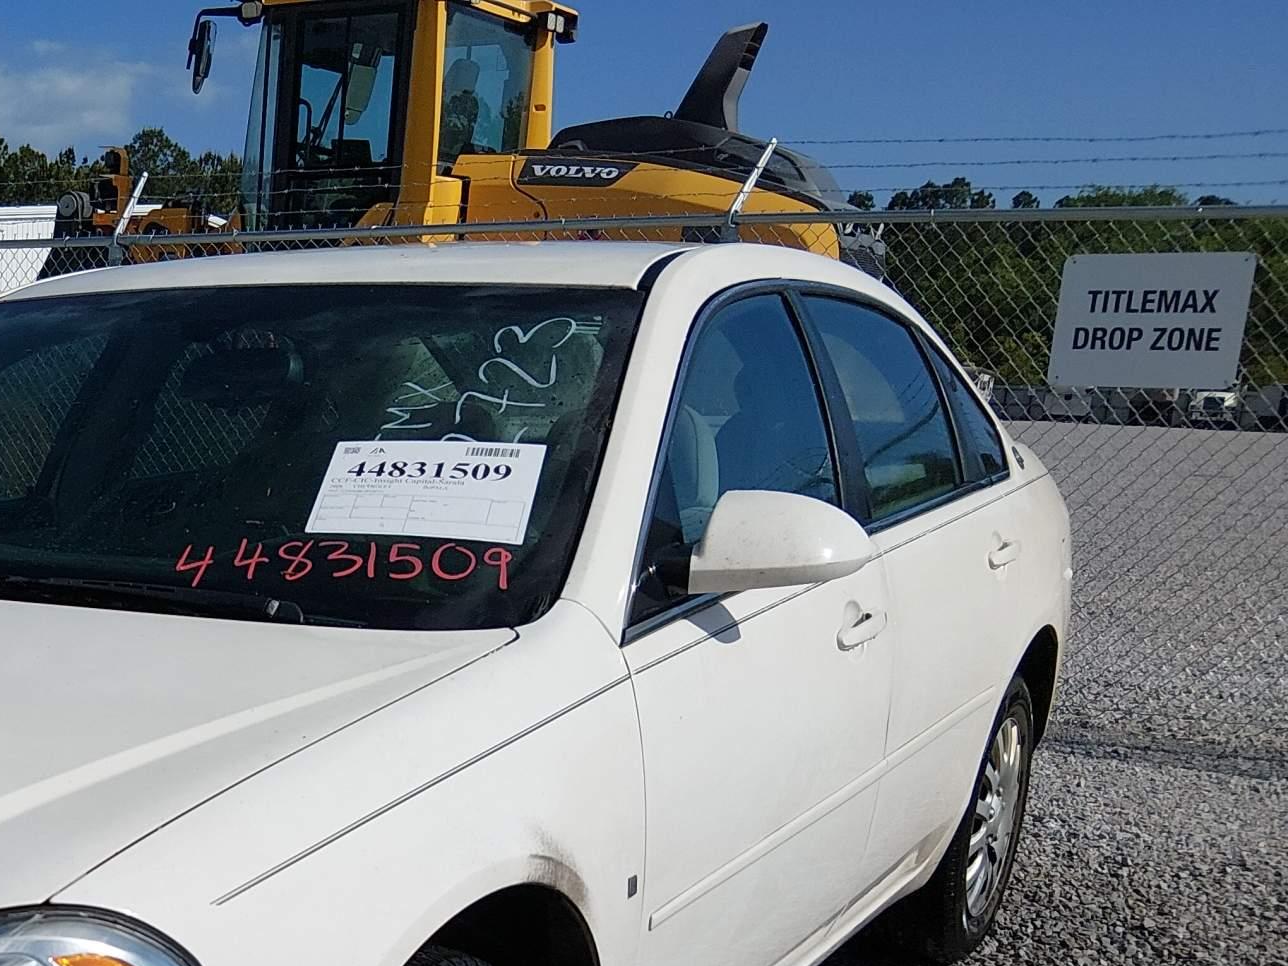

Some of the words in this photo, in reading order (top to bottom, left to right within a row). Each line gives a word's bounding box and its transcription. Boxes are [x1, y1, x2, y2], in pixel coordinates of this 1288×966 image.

[532, 165, 619, 179] VOLVO
[1087, 289, 1220, 314] TITLEMAX
[1072, 327, 1144, 351] DROP
[1149, 327, 1222, 351] ZONE
[347, 461, 513, 481] 44831509
